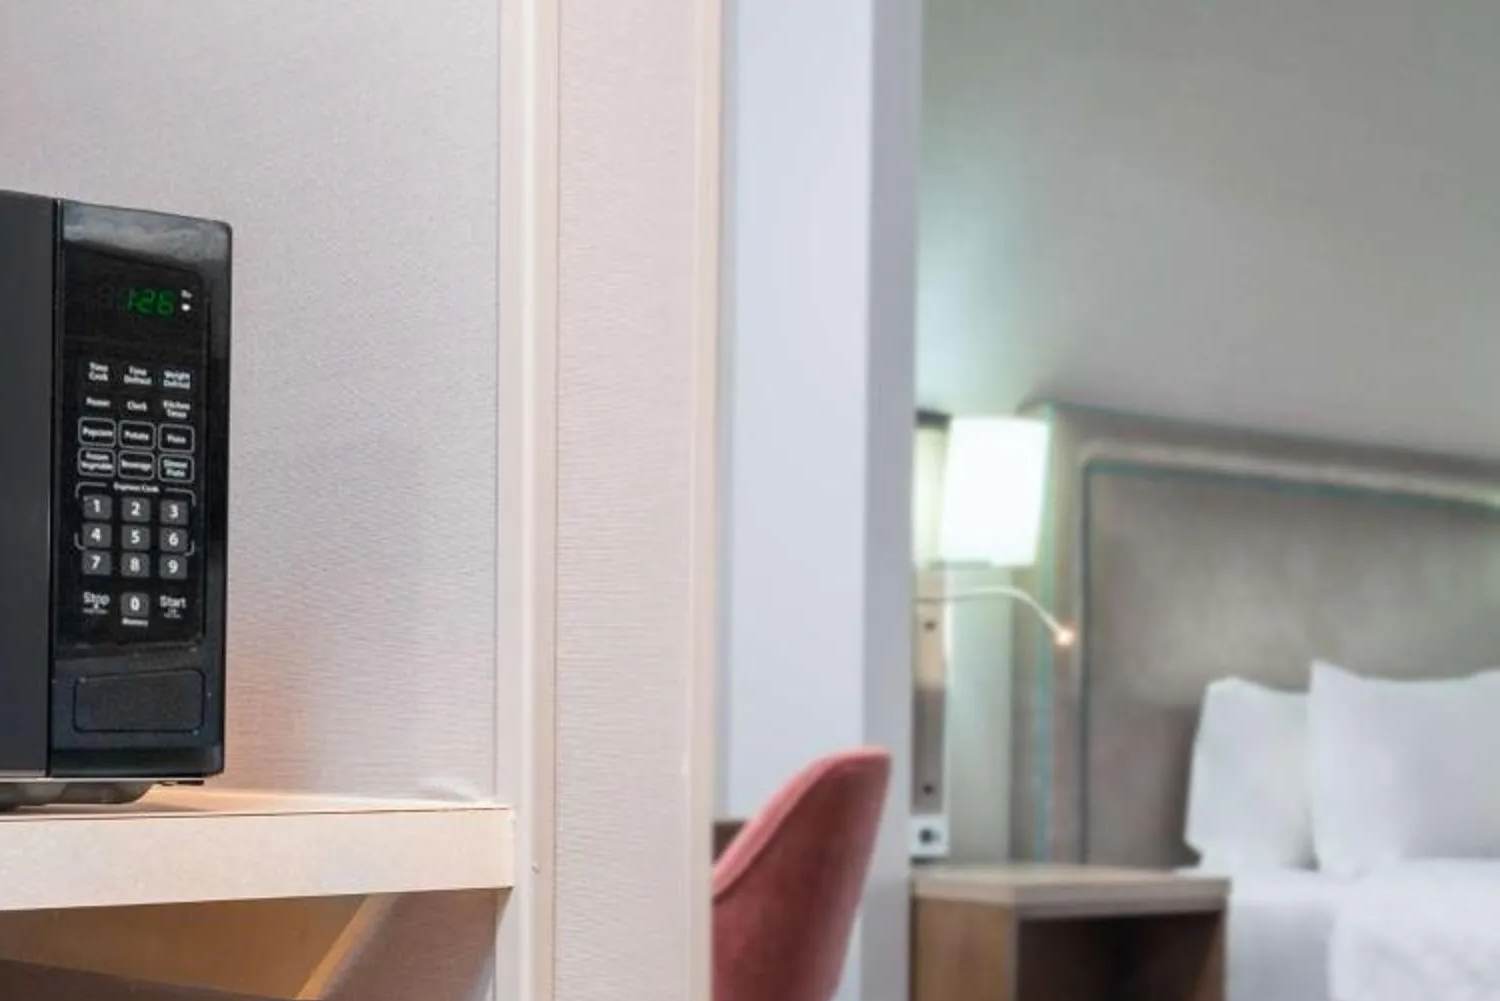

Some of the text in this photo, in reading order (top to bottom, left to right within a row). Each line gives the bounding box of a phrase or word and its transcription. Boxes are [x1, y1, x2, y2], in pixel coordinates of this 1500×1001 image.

[93, 498, 100, 513] 1
[131, 501, 140, 516] 2
[169, 504, 179, 519] 3
[91, 527, 101, 542] 4
[131, 529, 140, 544] 5
[169, 532, 179, 546] 6
[91, 554, 101, 569] 7
[130, 557, 140, 572] 8
[168, 559, 179, 574] 9
[83, 591, 110, 607] Stop
[130, 595, 140, 611] 0
[160, 595, 186, 609] Start
